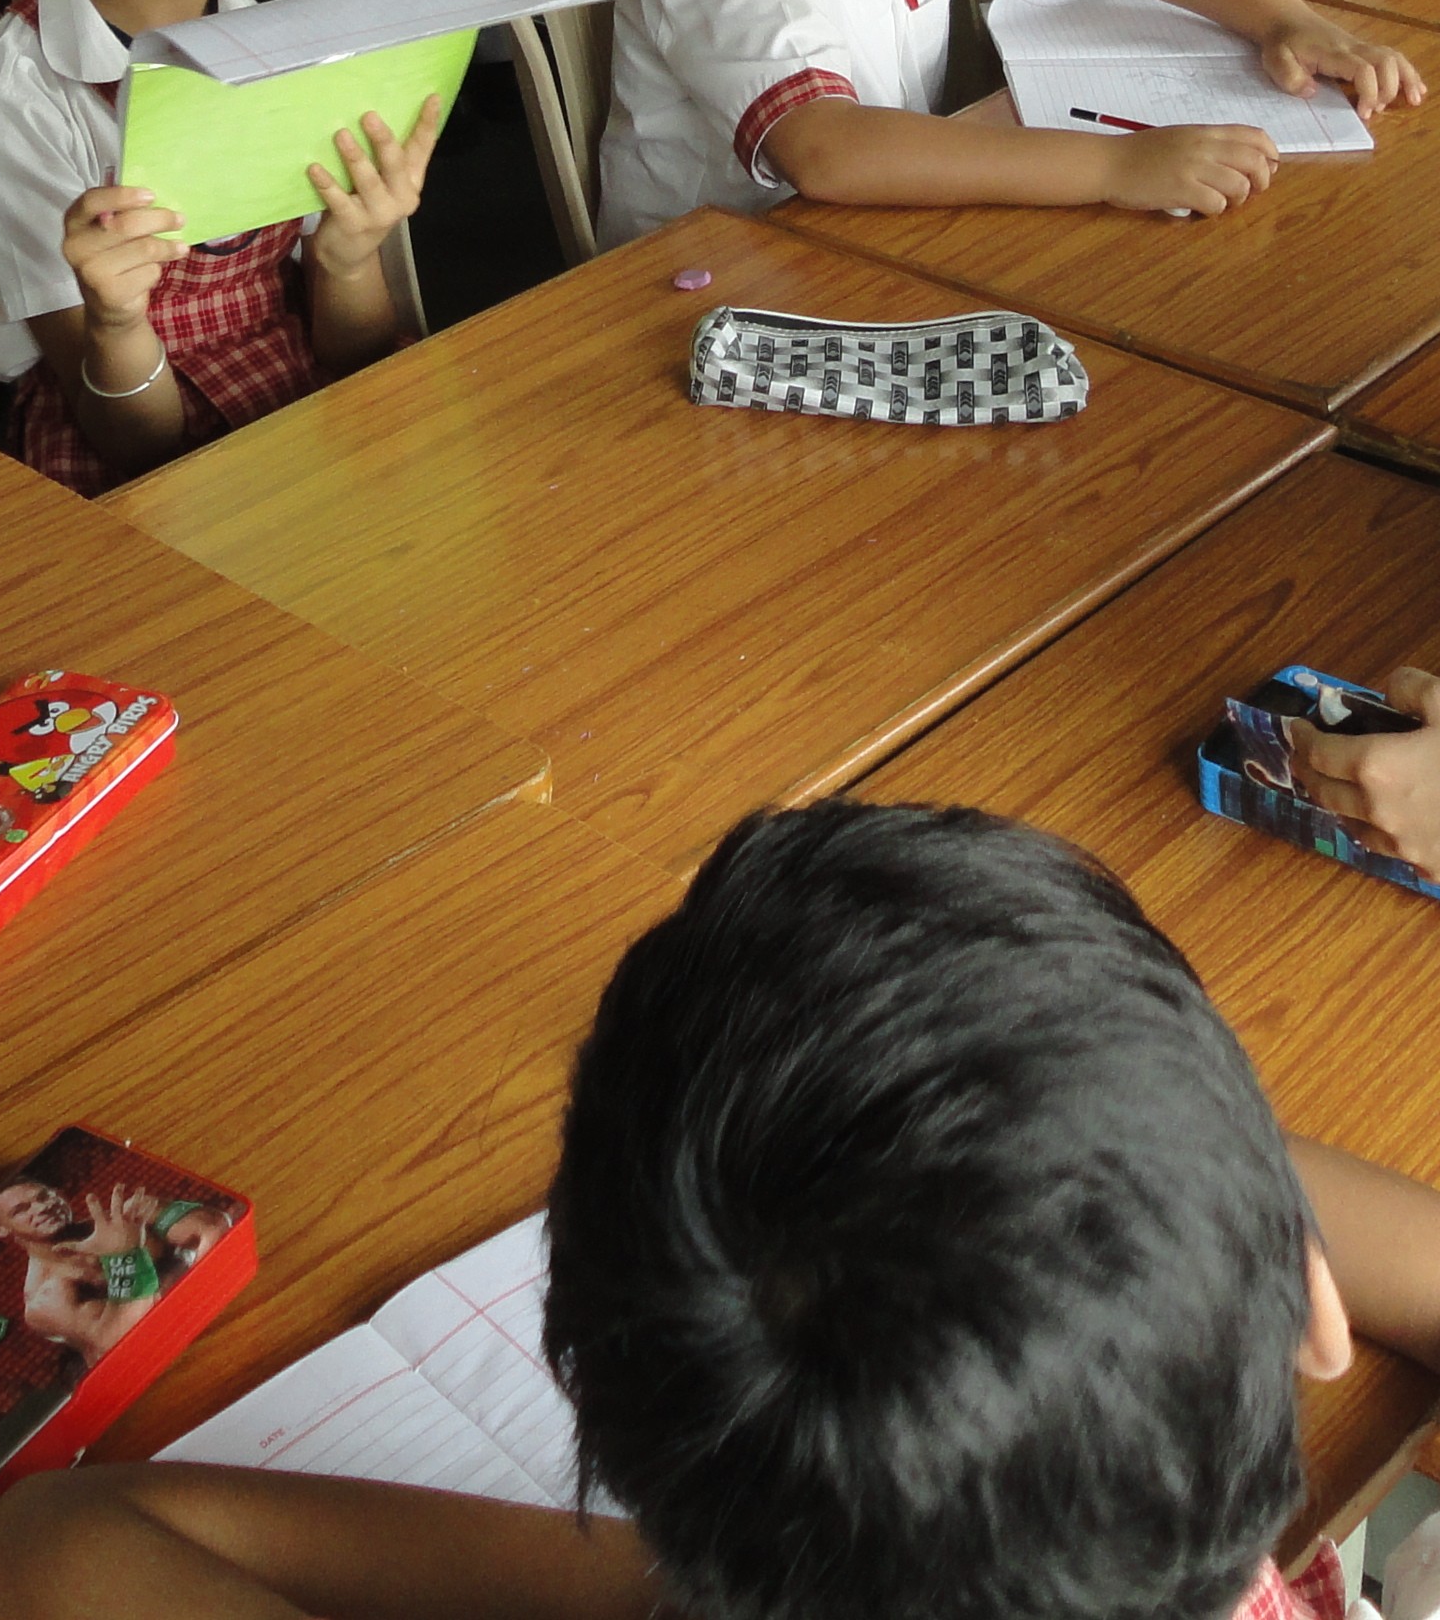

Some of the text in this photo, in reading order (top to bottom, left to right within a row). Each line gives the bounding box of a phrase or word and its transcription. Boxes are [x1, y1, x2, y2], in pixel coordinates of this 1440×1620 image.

[62, 695, 158, 783] ANGRY BIRDS
[258, 1426, 287, 1450] DATE
